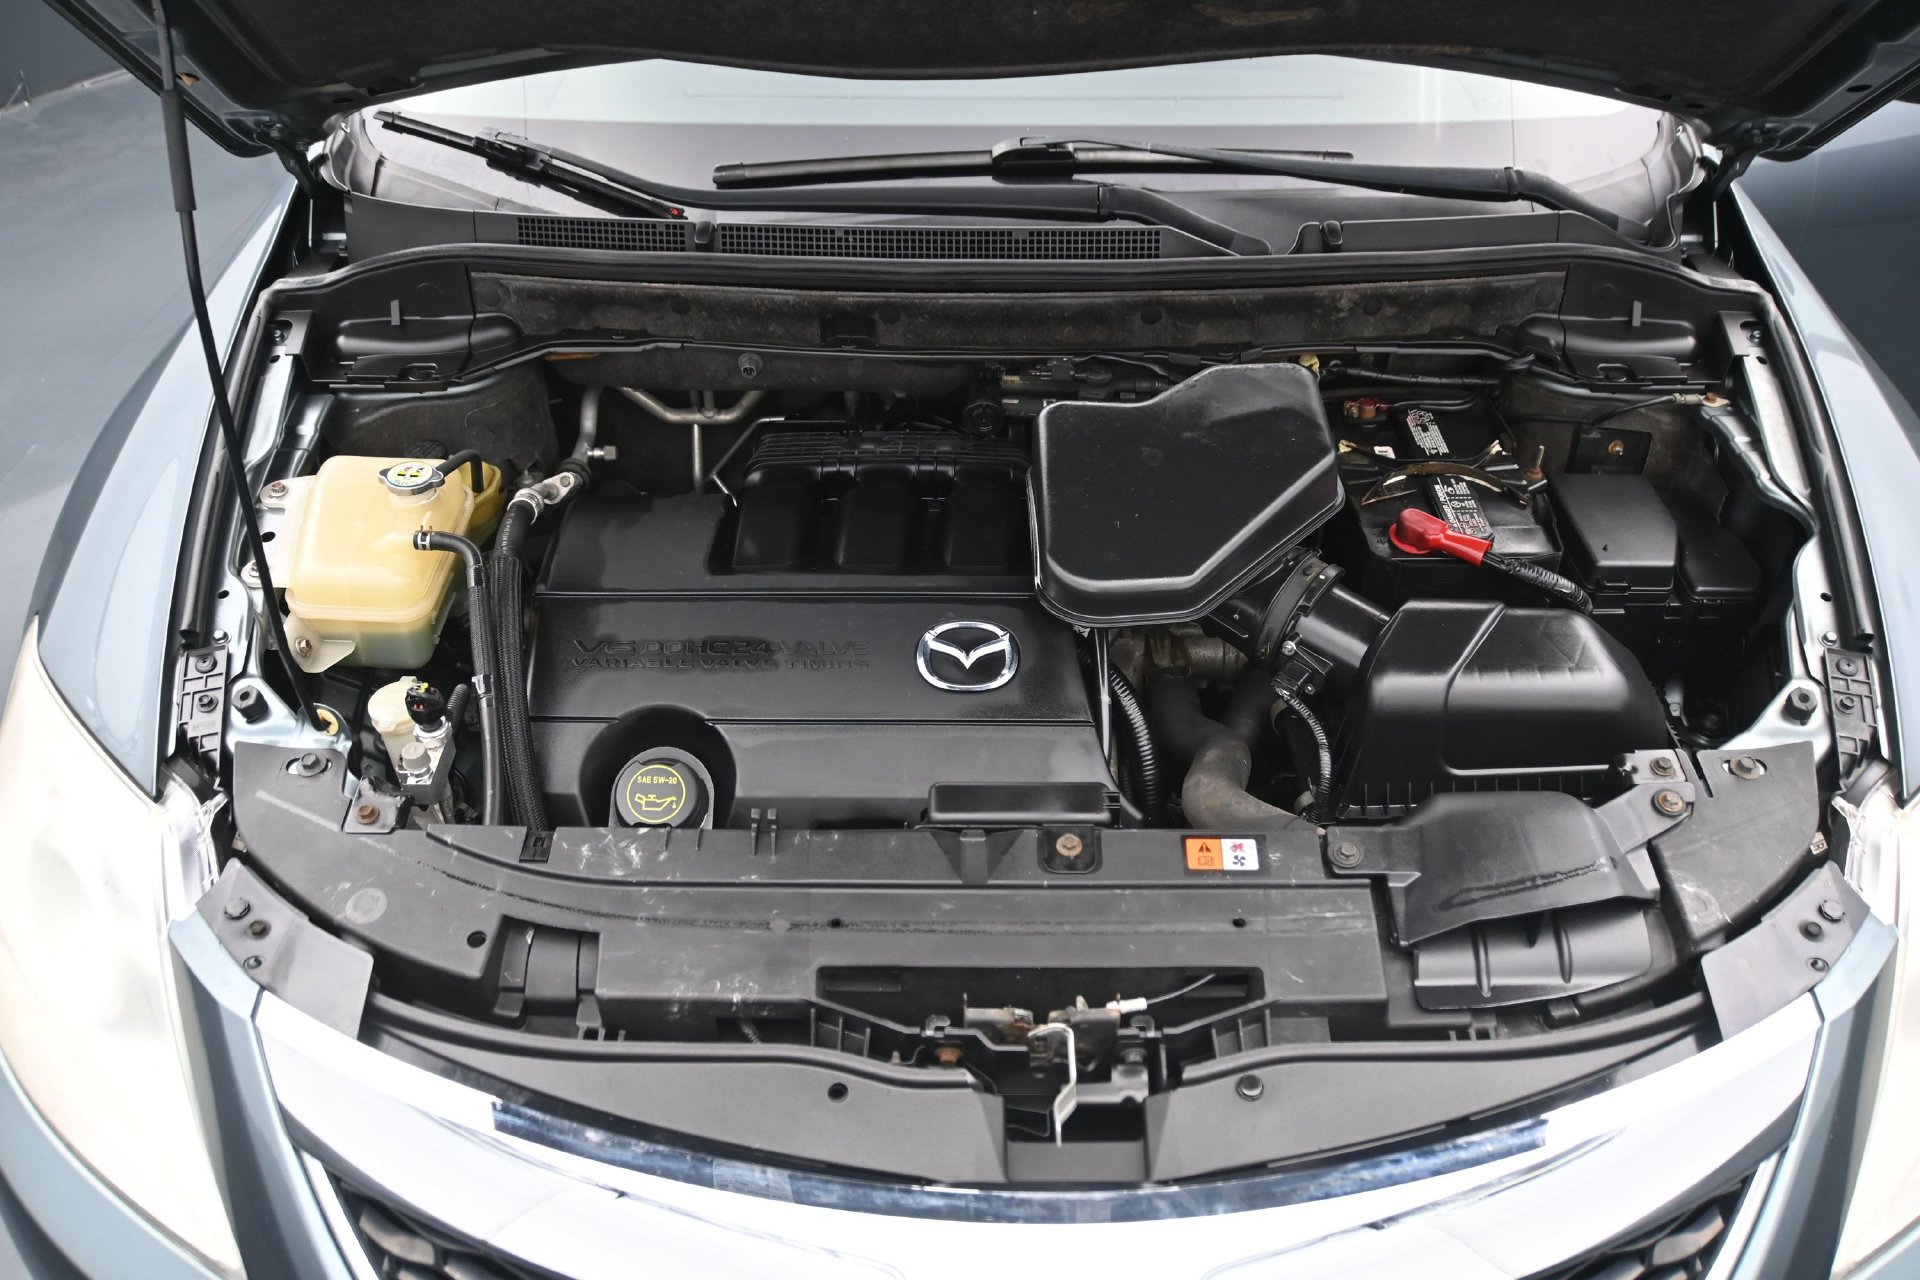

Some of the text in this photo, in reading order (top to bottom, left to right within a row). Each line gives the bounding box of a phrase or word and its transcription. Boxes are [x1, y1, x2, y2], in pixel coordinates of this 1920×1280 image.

[573, 639, 636, 654] V6
[639, 639, 729, 655] DOHC
[571, 658, 869, 669] VARIABLE VALVE TIMING
[637, 775, 678, 785] SAE 5W-20
